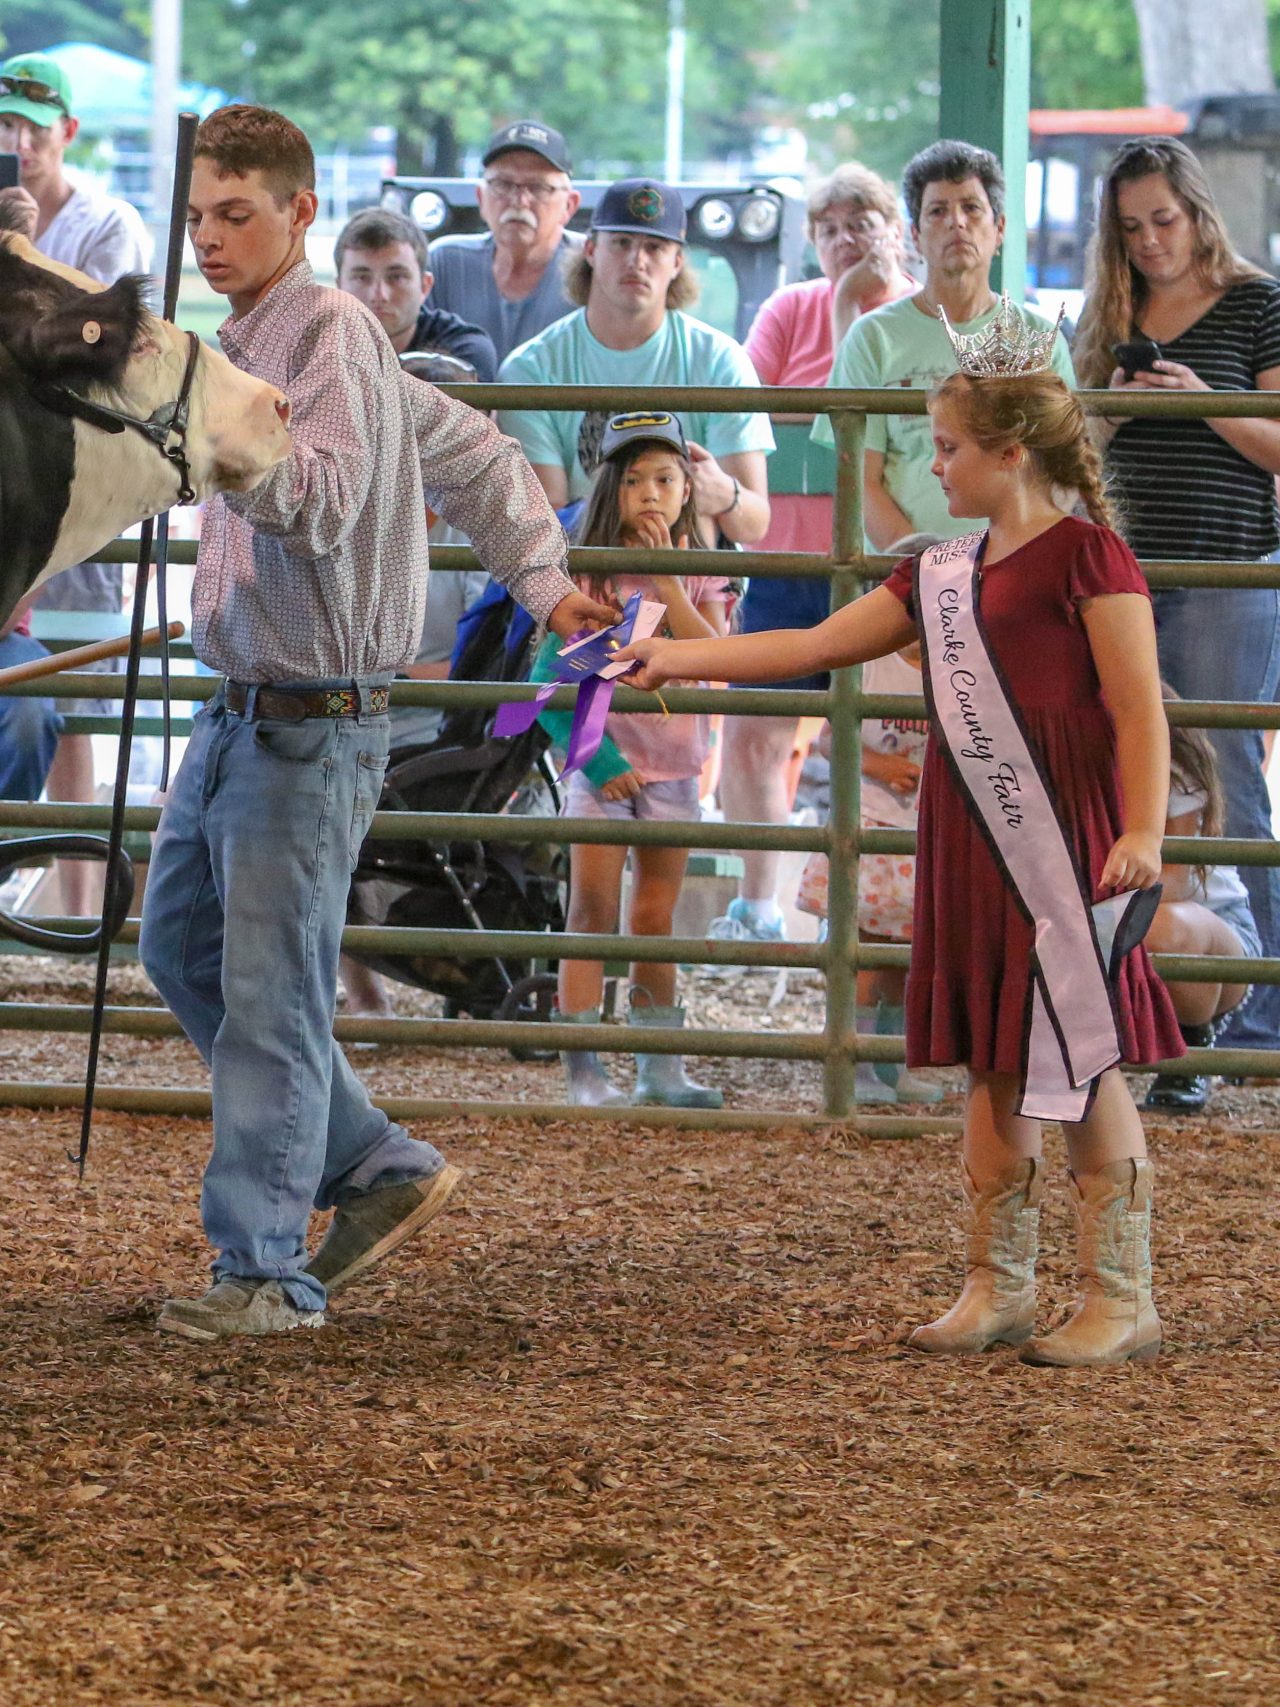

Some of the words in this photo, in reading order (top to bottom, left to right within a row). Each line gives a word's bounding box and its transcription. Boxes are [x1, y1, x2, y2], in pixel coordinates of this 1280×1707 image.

[929, 548, 969, 566] MISS
[938, 588, 965, 666] Clarke
[950, 669, 994, 763] County
[988, 762, 1022, 829] Fair
